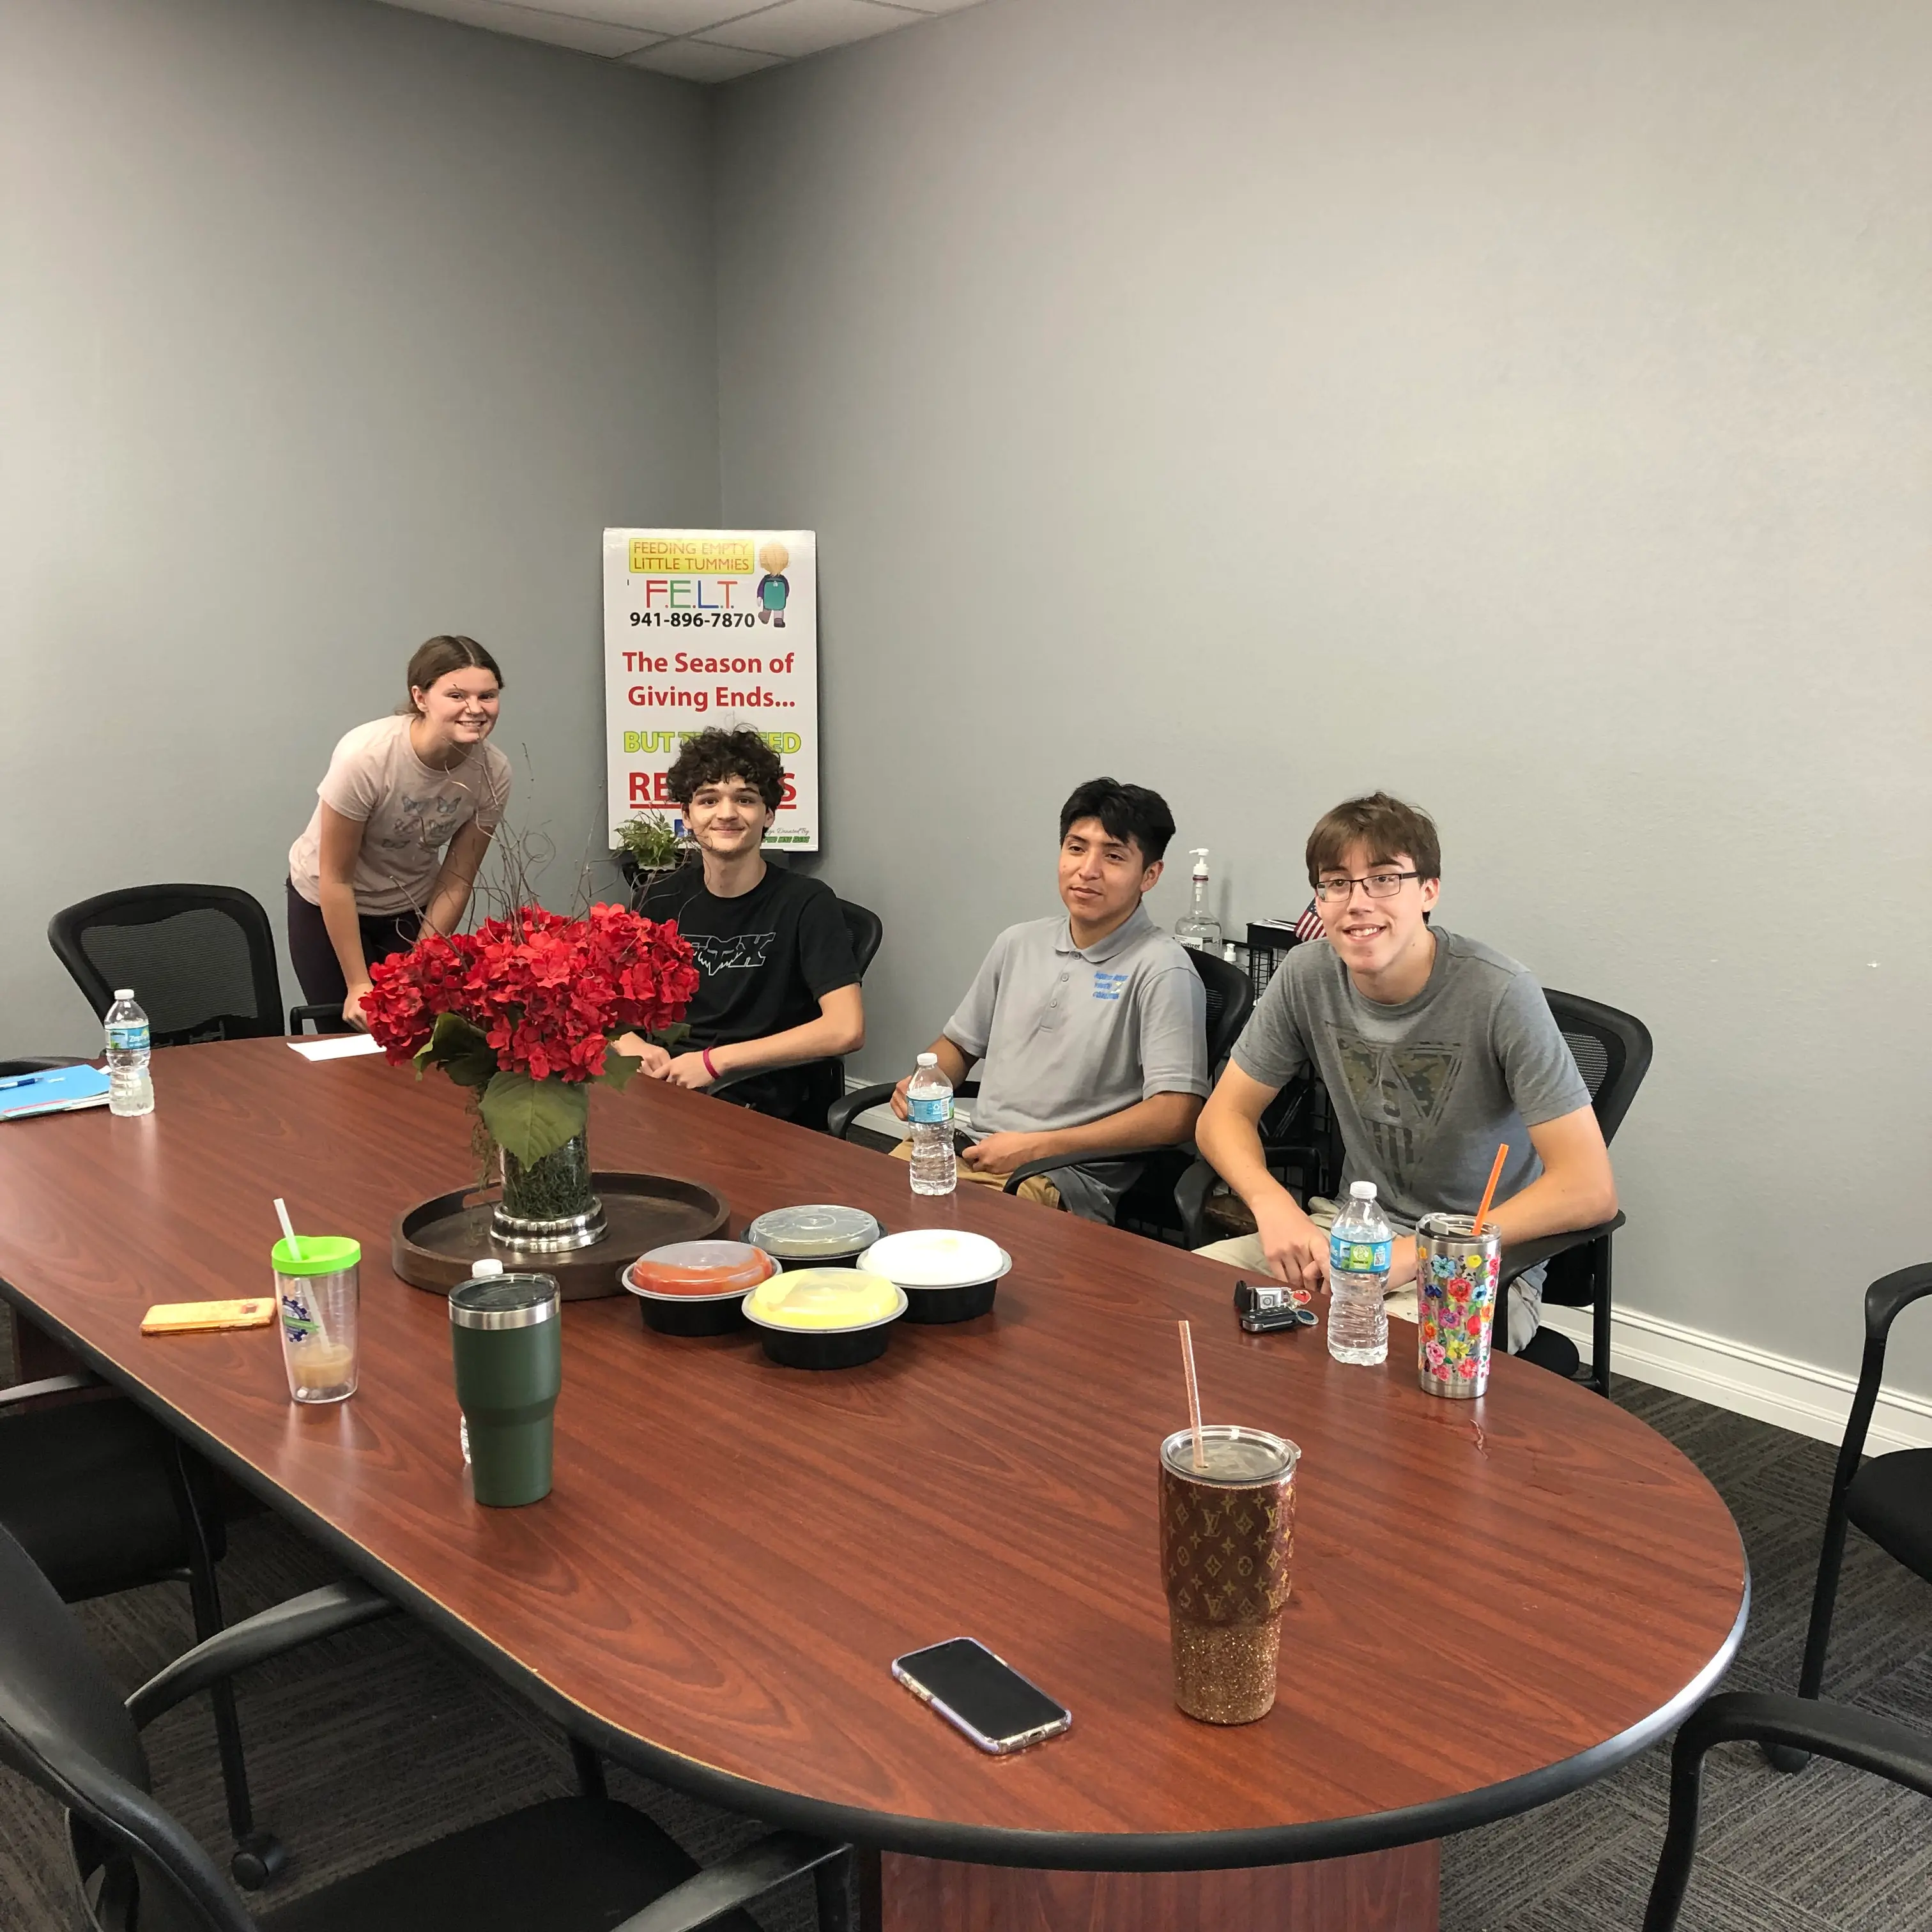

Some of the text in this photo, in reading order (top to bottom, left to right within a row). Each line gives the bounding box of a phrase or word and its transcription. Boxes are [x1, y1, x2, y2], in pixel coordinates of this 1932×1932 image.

[634, 542, 748, 555] FEEDING EMPTY
[634, 558, 749, 571] LITTLE TUMMIES
[646, 580, 737, 609] F.E.L.T.
[630, 612, 755, 627] 941-896-7870
[622, 652, 794, 673] The Season of
[628, 686, 795, 712] Giving Ends...
[624, 732, 675, 753] BUT
